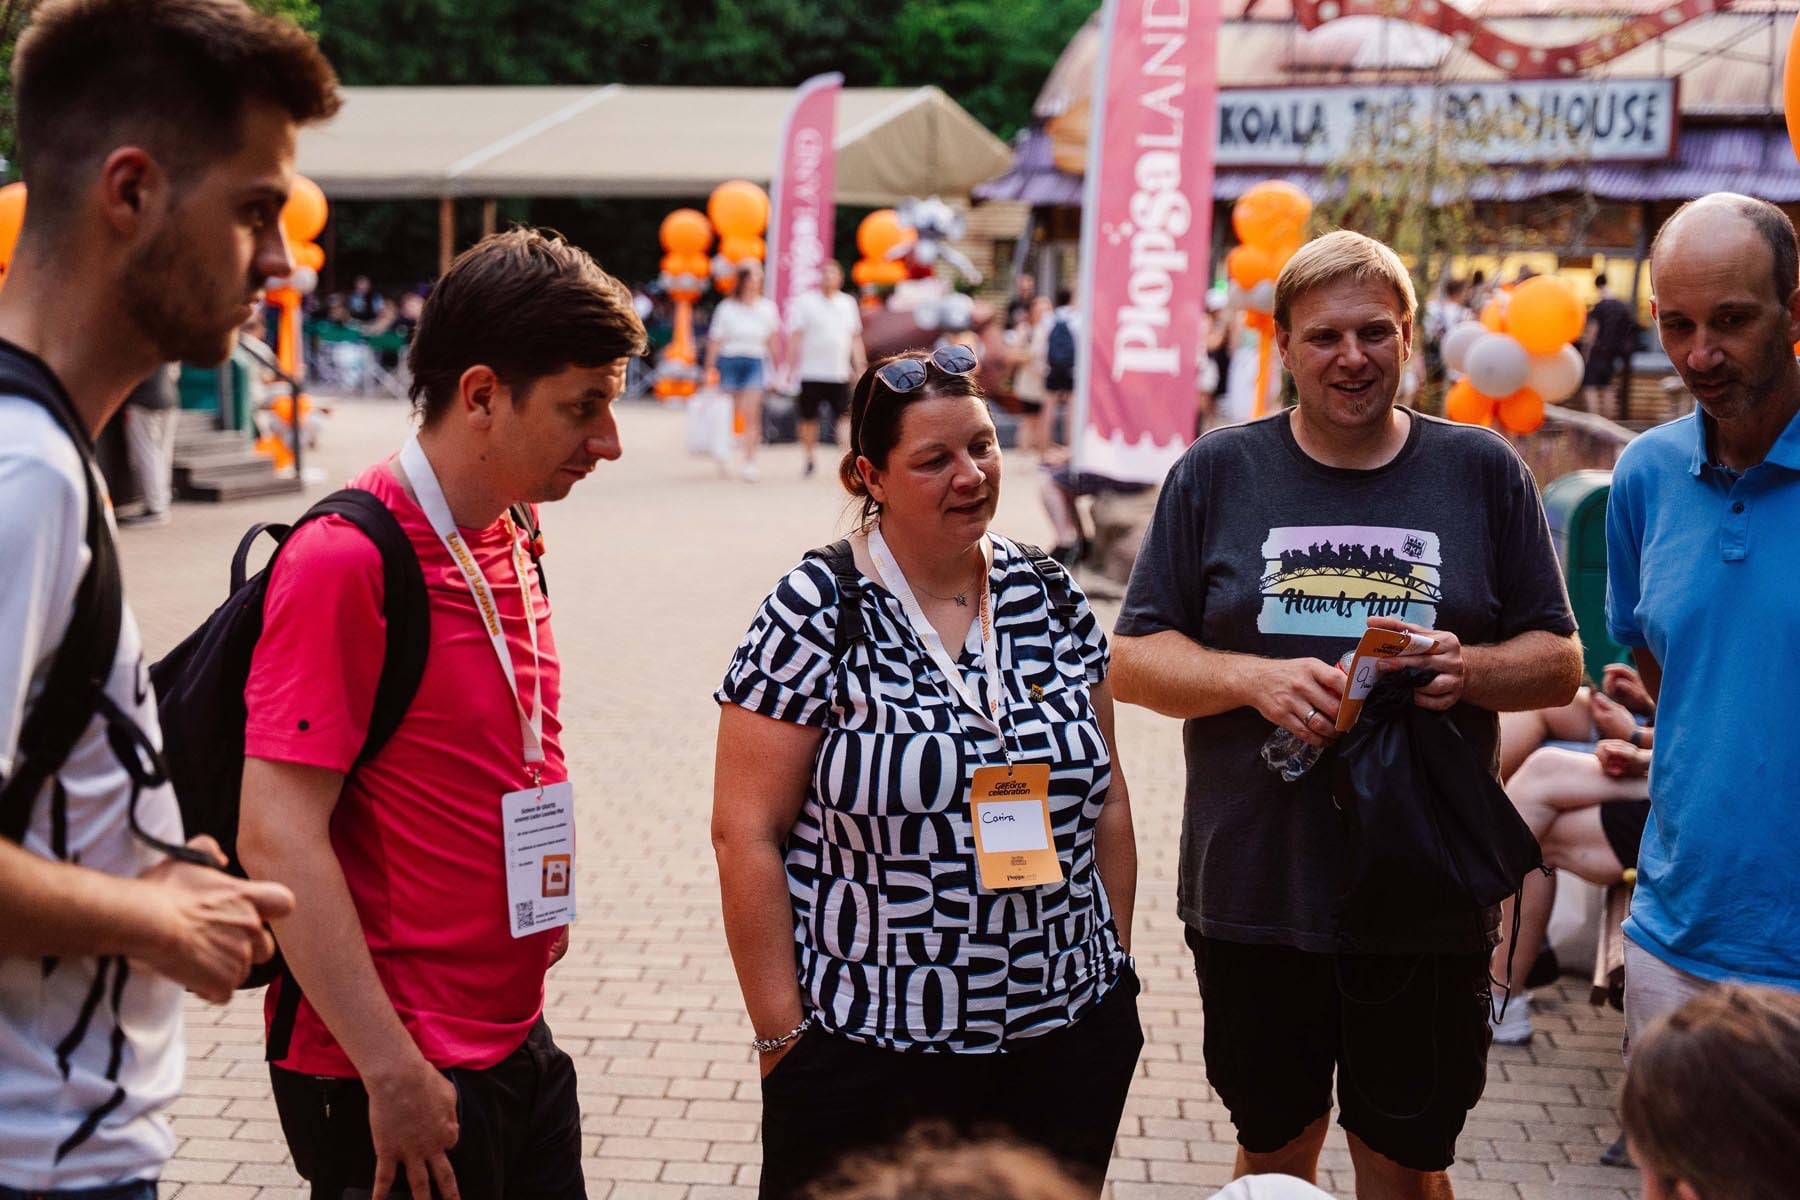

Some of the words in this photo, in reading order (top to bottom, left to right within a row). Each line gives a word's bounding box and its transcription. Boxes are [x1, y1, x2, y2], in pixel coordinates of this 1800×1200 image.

[1220, 102, 1330, 146] KOALA
[1280, 587, 1358, 618] Hands
[988, 789, 1031, 797] celebration
[995, 781, 1027, 791] GeForce
